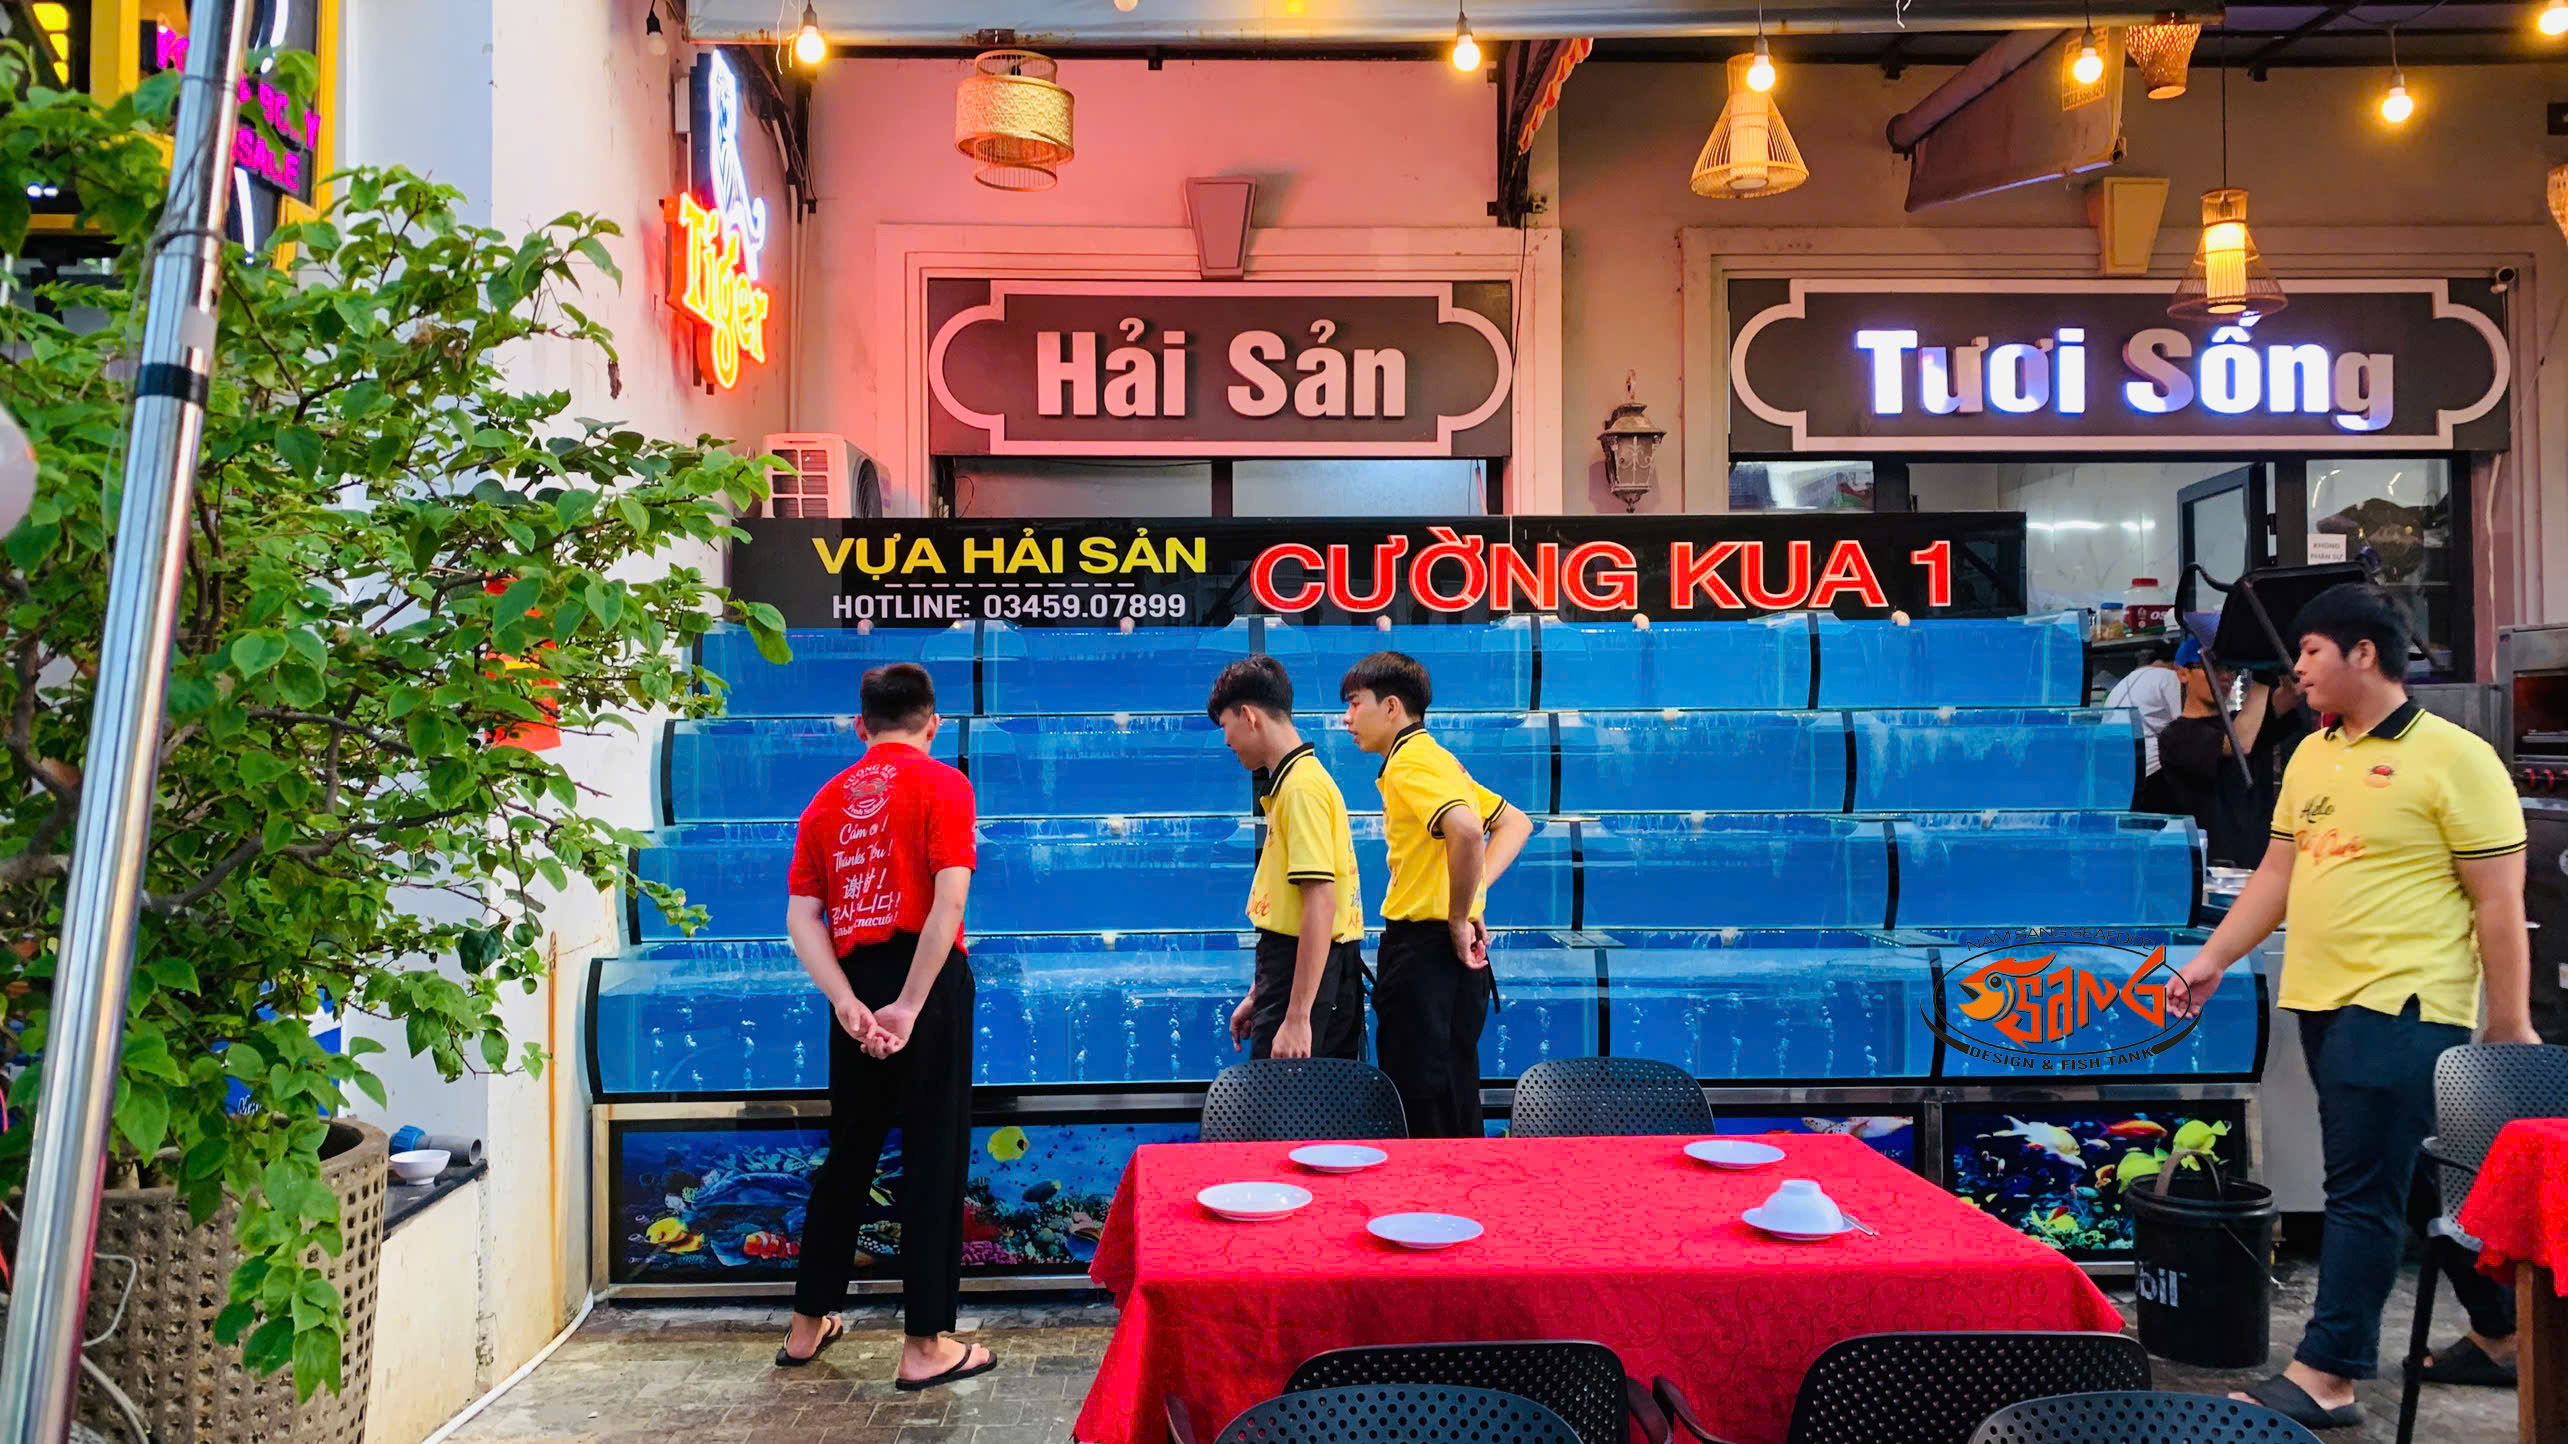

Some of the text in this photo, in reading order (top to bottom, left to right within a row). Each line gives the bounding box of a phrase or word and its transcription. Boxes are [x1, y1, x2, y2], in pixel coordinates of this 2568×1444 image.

[679, 191, 769, 390] Tiger
[1036, 317, 1407, 417] Hải Sản
[1855, 310, 2395, 431] Tươi Sống
[811, 528, 1207, 581] VỰA HẢI SẢN
[1249, 526, 1952, 613] CƯỜNG KUA 1
[832, 593, 1186, 619] HOTLINE: 03459.07899
[832, 848, 865, 872] Thanks
